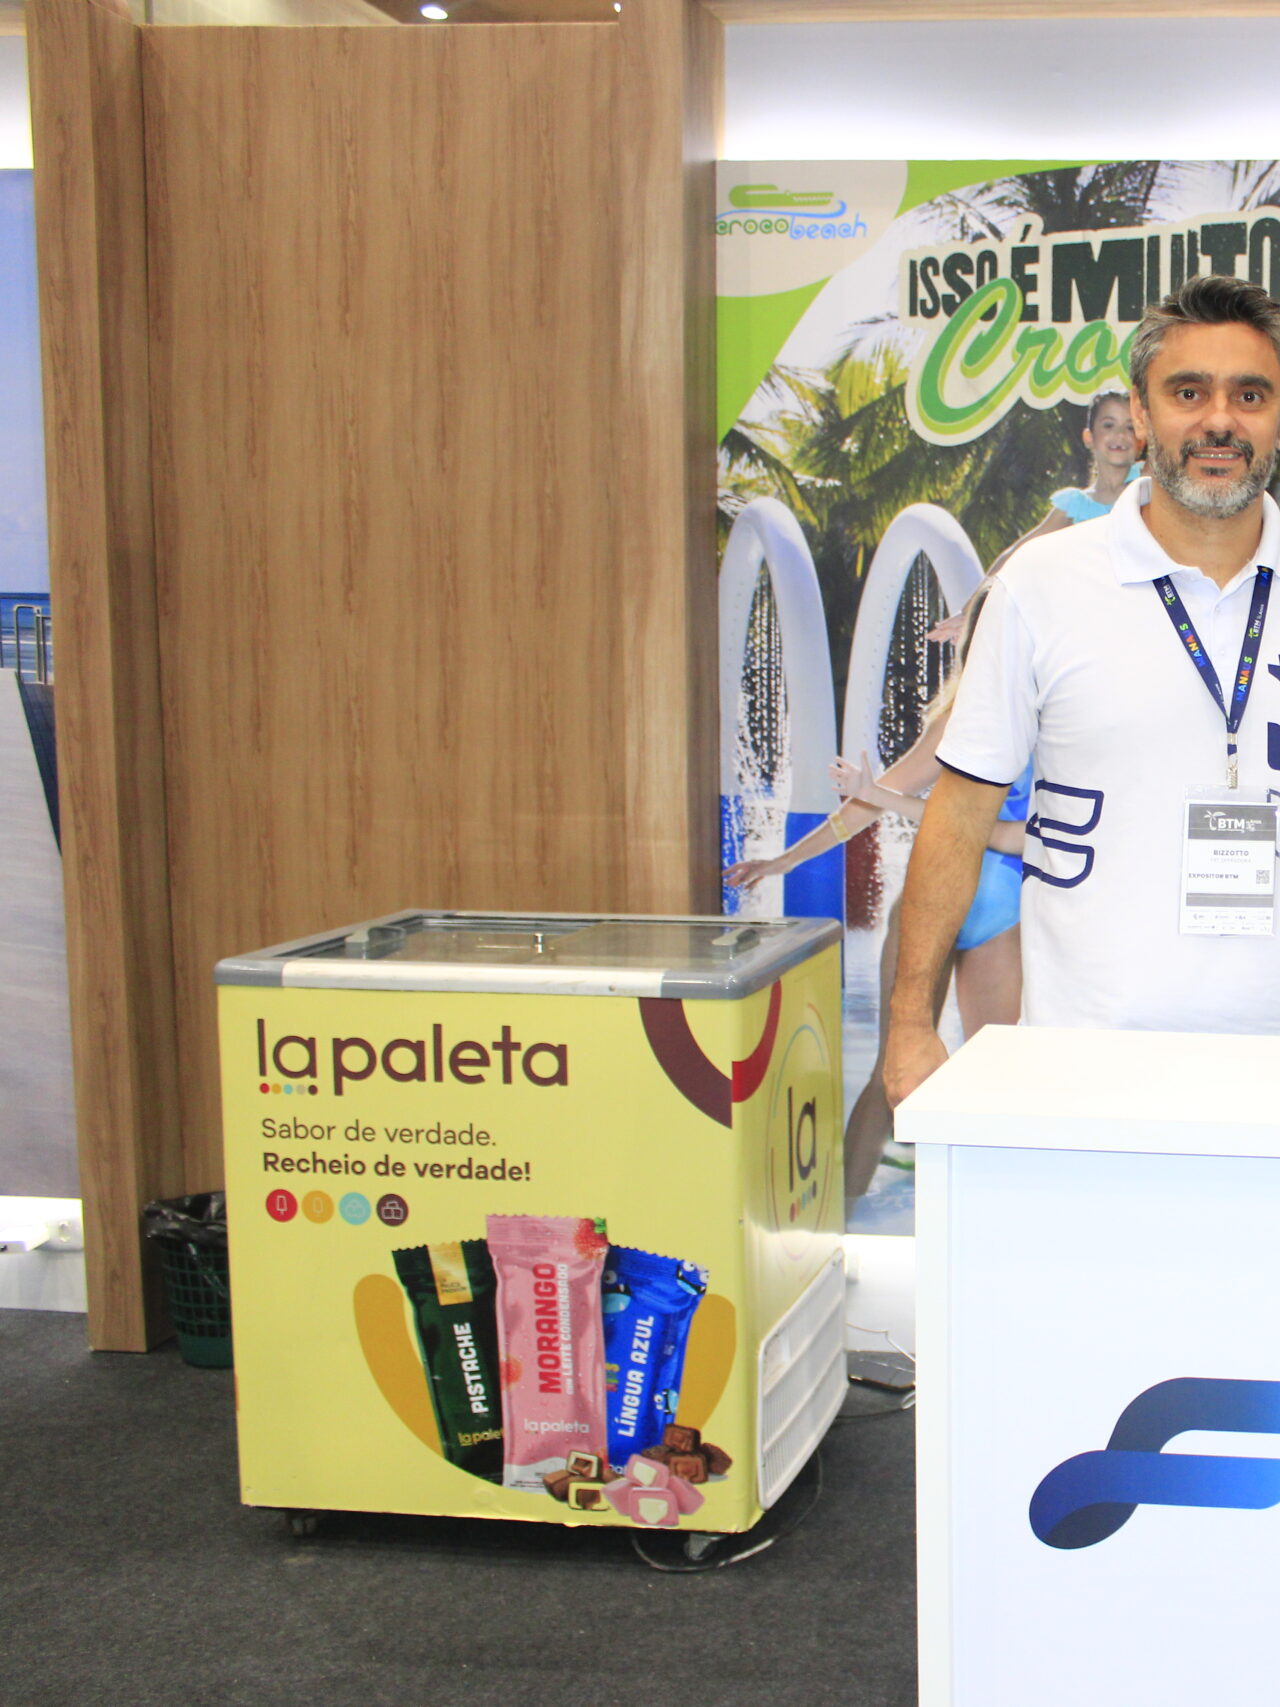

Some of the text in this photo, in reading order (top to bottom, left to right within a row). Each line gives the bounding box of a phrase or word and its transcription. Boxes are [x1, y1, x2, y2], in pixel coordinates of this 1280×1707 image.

[908, 250, 998, 323] ISSO
[1010, 222, 1040, 323] É
[1180, 623, 1207, 667] MANAUS
[1236, 656, 1253, 701] MANAUS
[1217, 818, 1245, 830] BTM
[1213, 849, 1249, 857] BIZZOTTO
[261, 1117, 497, 1146] Sabor de verdade.
[262, 1152, 532, 1181] Recheio de verdade!
[557, 1263, 573, 1341] CONDENSADO
[532, 1263, 562, 1394] MORANGO
[629, 1315, 655, 1365] AZUL
[453, 1322, 490, 1414] PISTACHE
[614, 1369, 645, 1438] LÍNGUA
